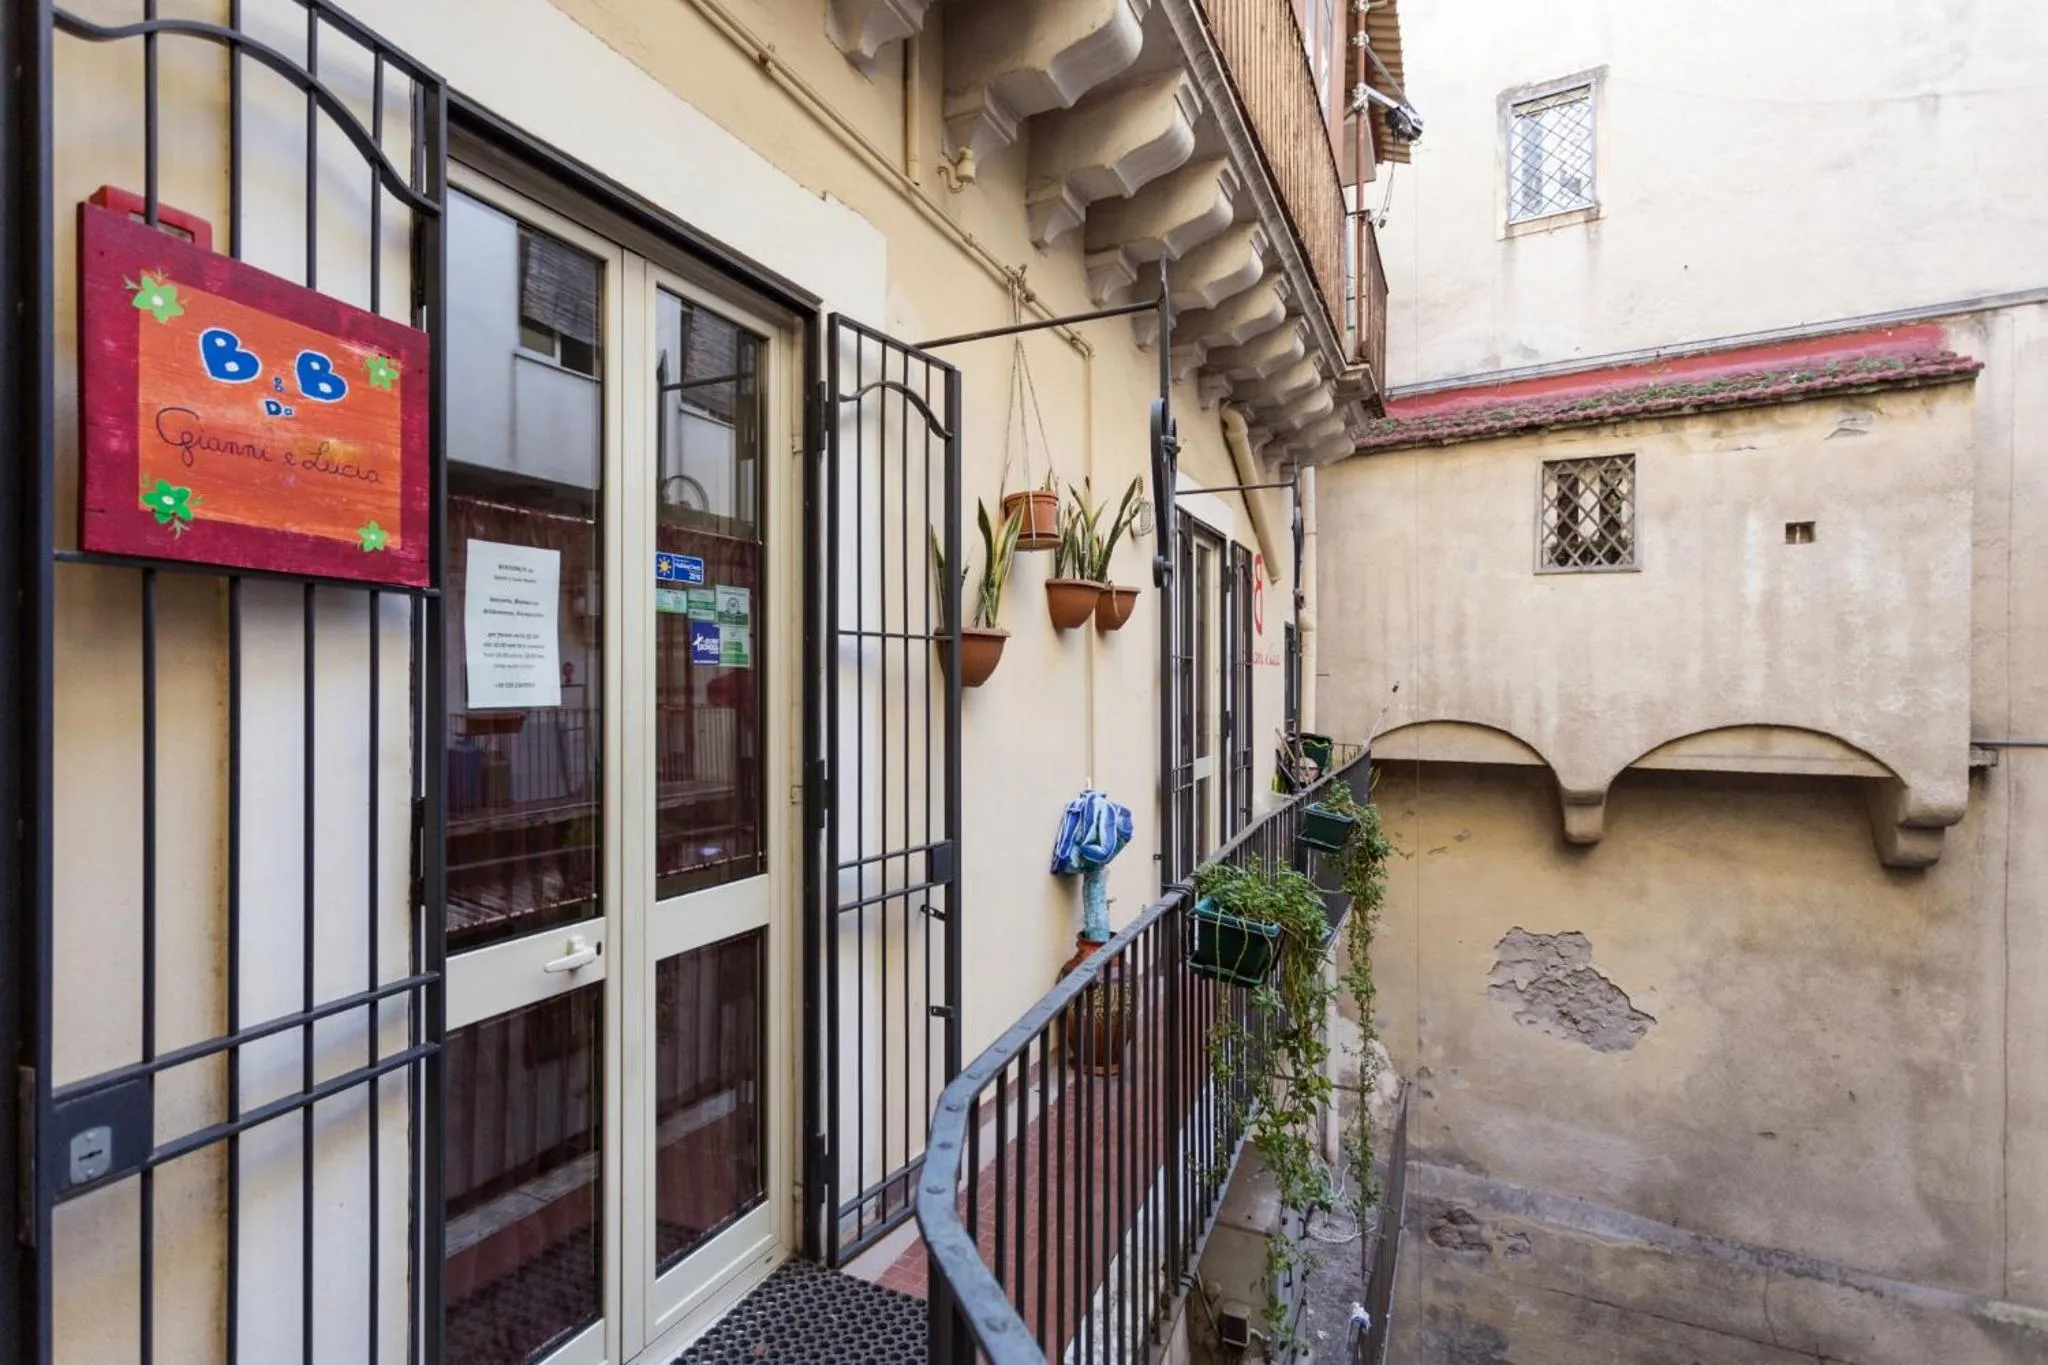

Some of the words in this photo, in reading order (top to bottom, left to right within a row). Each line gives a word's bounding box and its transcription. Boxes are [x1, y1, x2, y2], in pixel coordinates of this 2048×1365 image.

[199, 327, 262, 384] B
[295, 349, 348, 403] B
[155, 407, 272, 468] Gianni
[283, 451, 296, 466] e
[301, 441, 383, 483] Lucia
